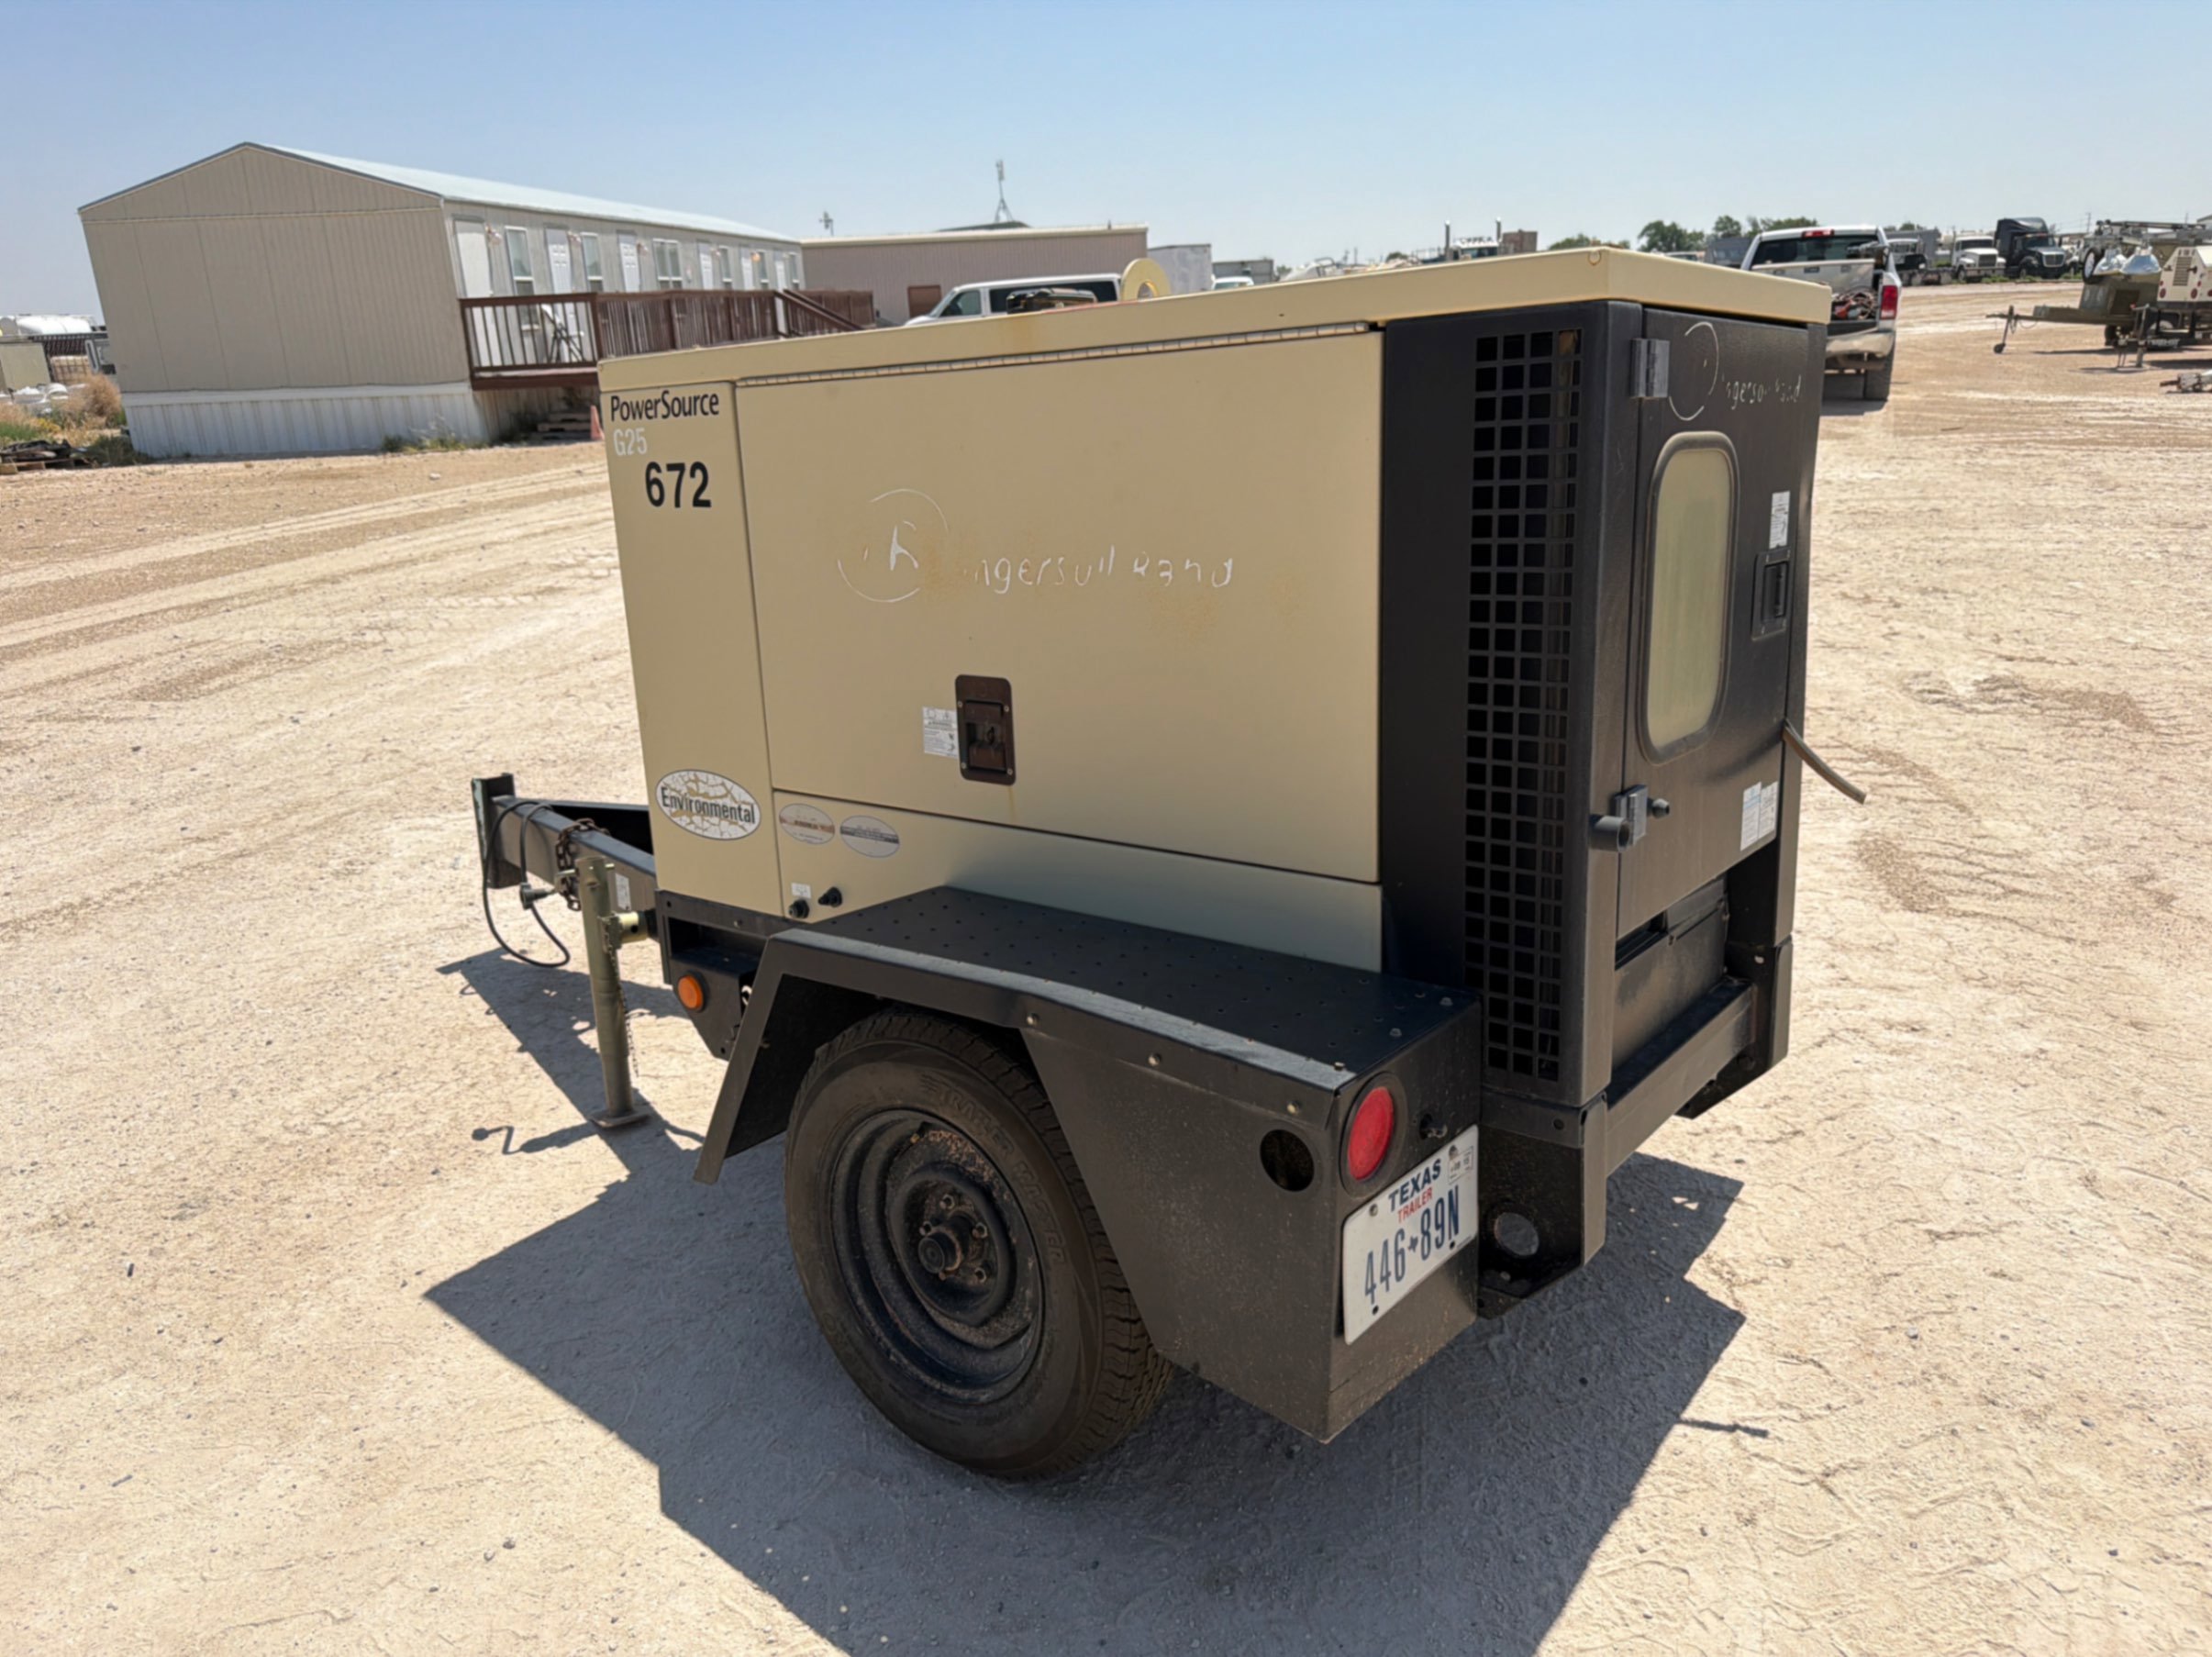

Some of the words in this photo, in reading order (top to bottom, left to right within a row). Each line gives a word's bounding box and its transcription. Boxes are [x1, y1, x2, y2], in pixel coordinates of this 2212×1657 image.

[610, 390, 719, 422] PowerSource
[613, 428, 648, 456] G25
[645, 462, 712, 508] 672
[660, 785, 756, 825] Environmental
[1388, 1159, 1442, 1212] TEXAS
[1397, 1187, 1433, 1224] TRAILER
